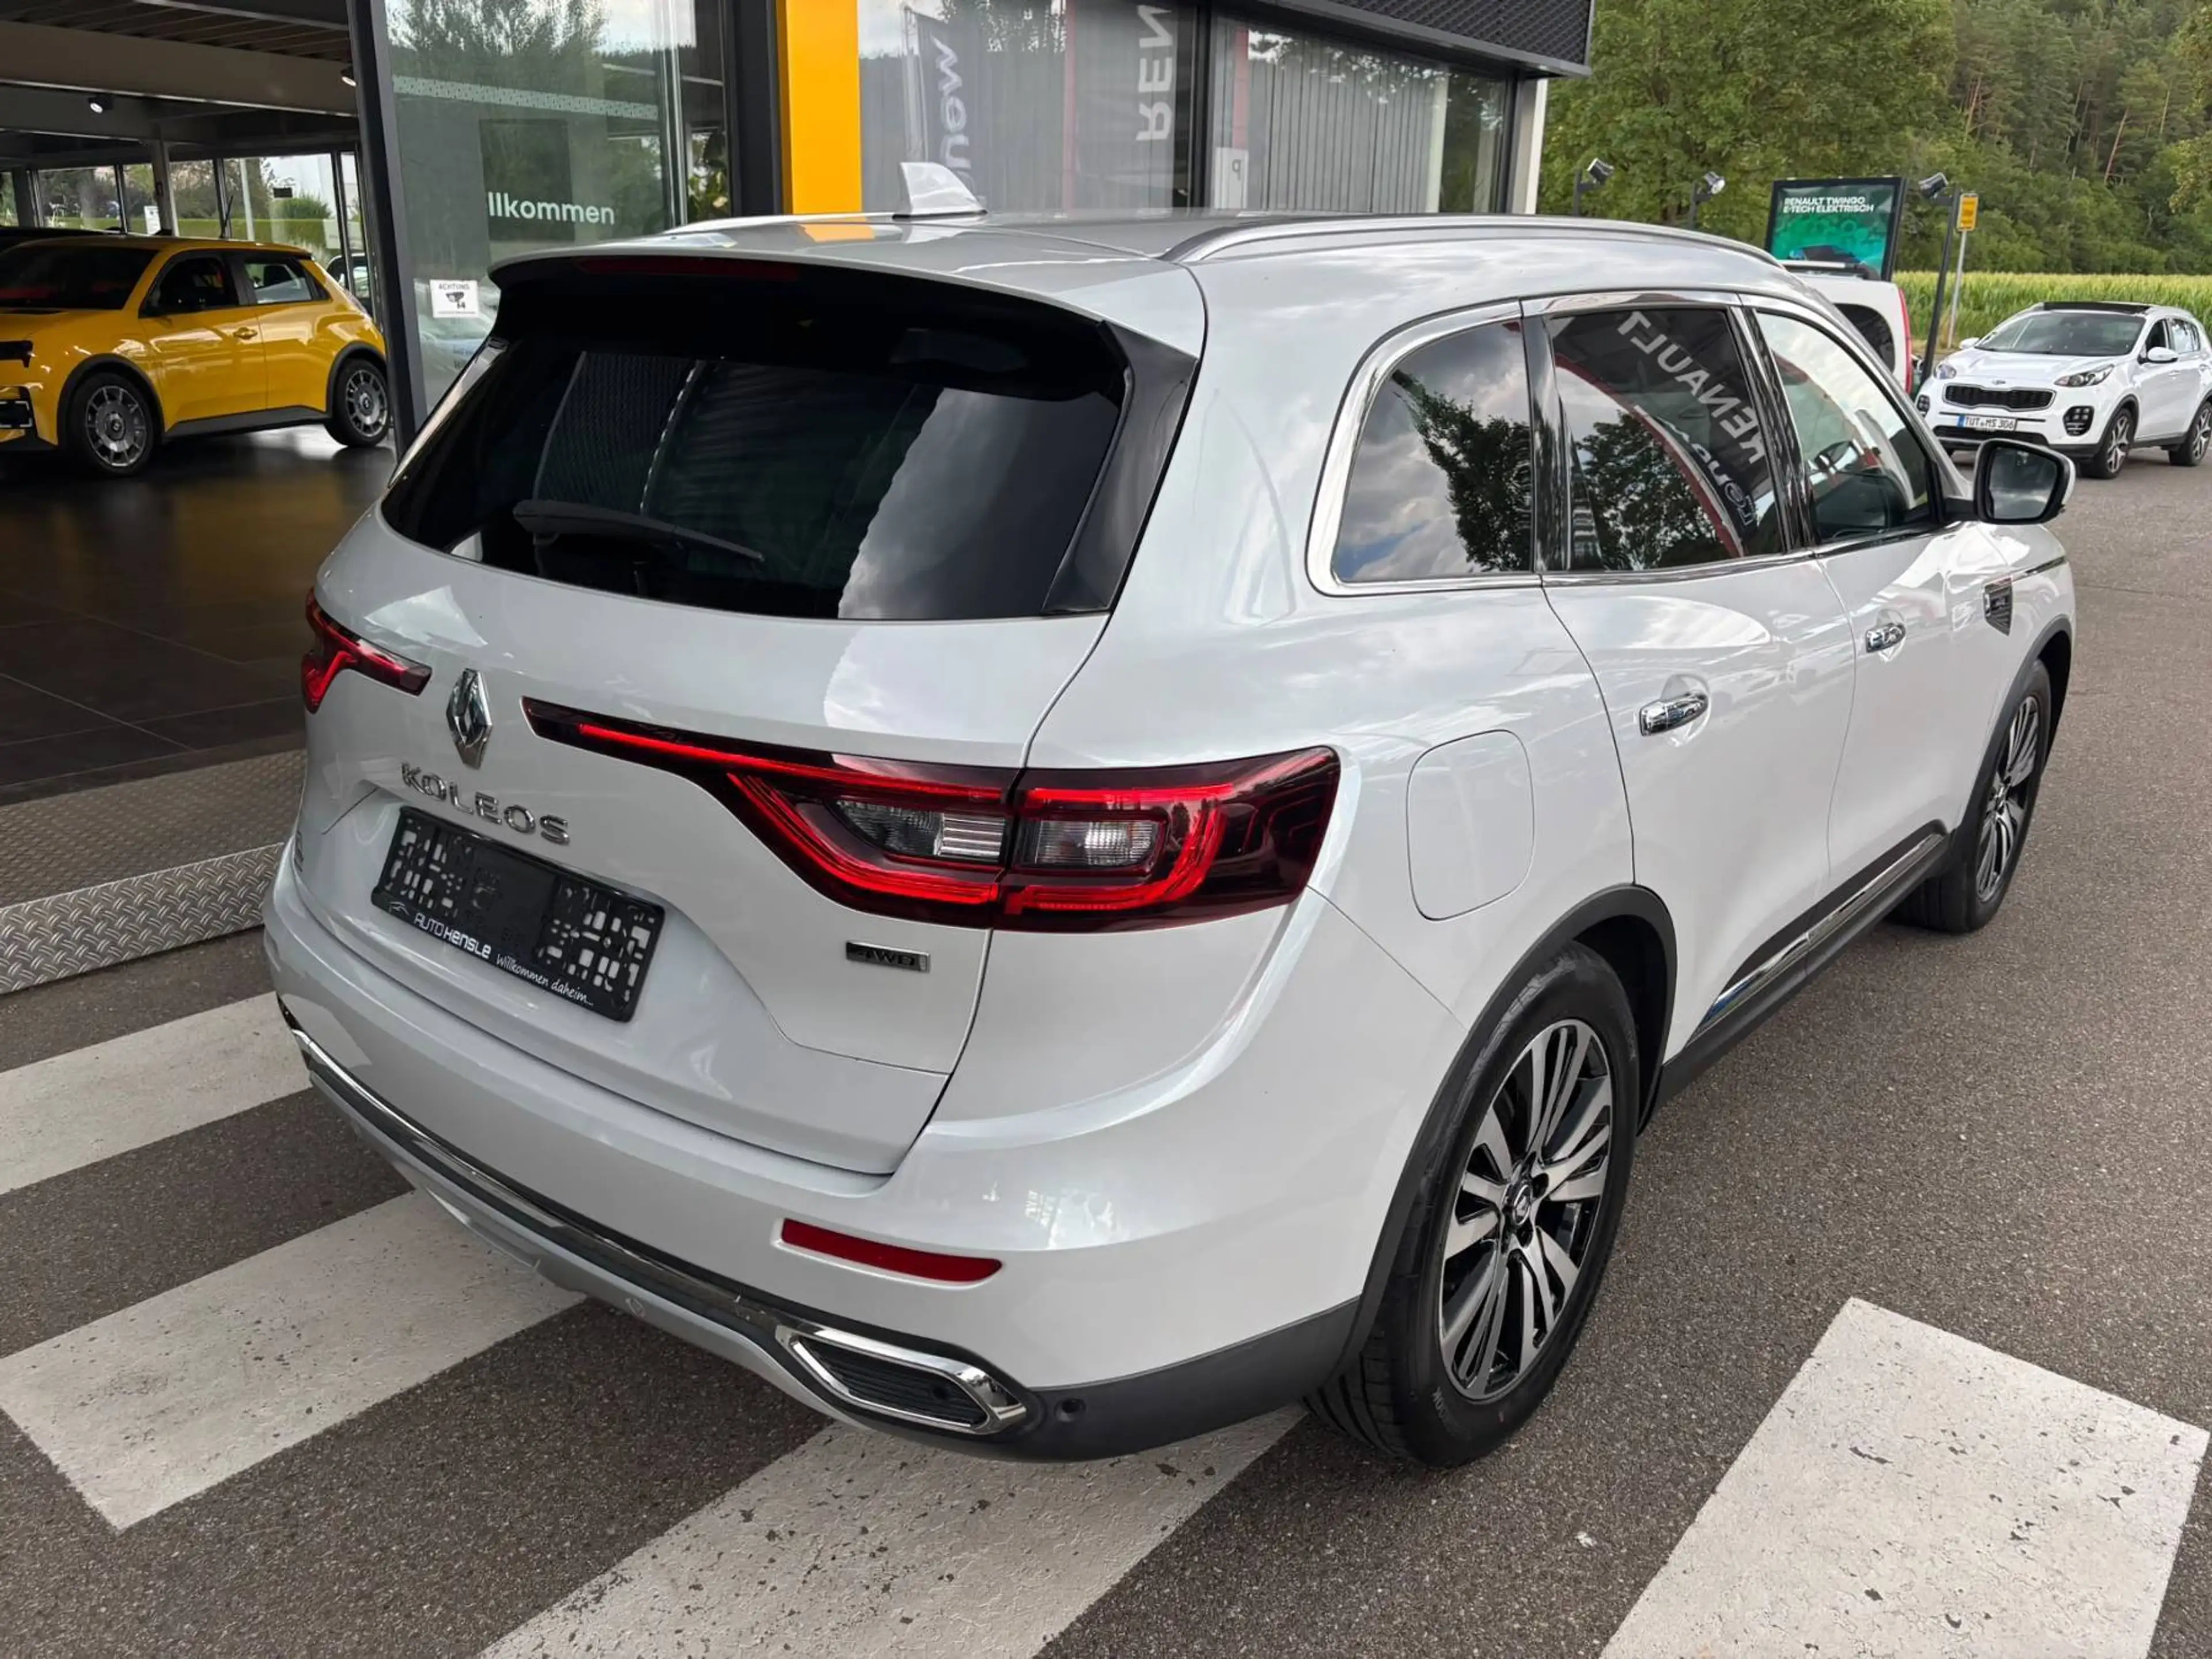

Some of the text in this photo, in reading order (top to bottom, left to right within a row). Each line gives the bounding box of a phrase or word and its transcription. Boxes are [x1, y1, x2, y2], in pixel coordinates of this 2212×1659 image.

[1785, 196, 1865, 206] RENAULT TWINGO
[1783, 204, 1874, 213] E-TECH ELEKTRISCH
[402, 762, 571, 846] KOLEOS
